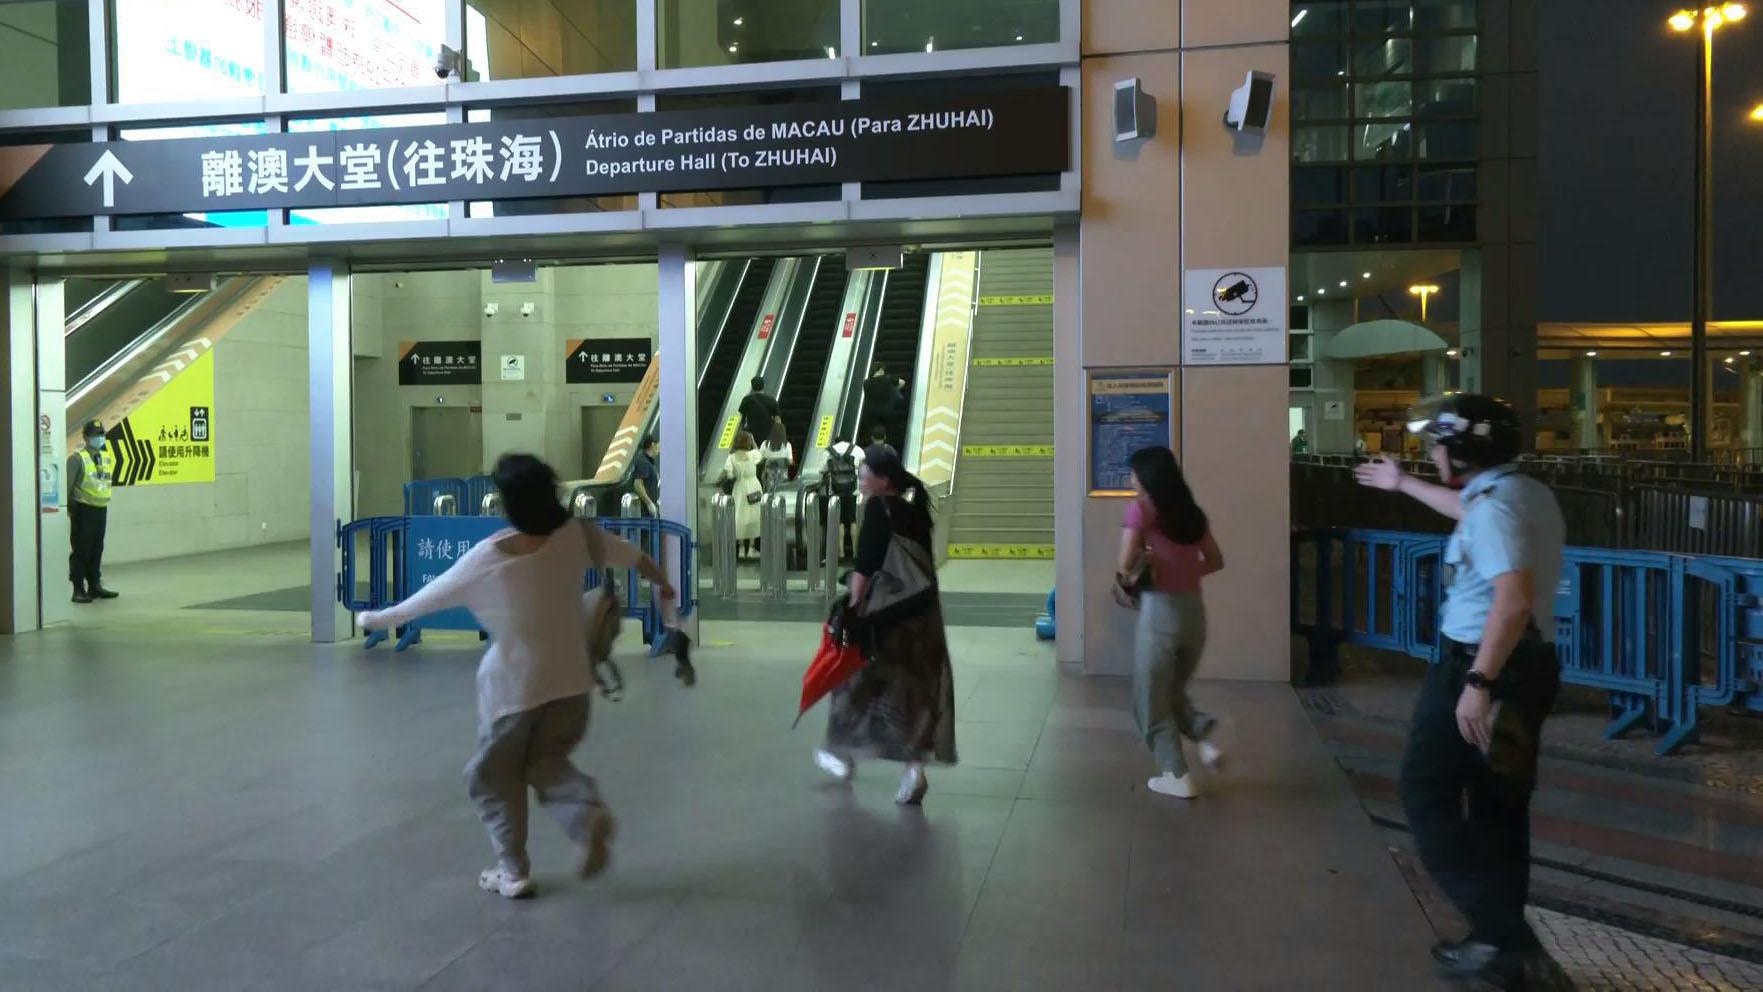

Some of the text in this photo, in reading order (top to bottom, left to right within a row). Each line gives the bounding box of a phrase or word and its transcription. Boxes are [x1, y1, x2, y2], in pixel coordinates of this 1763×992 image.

[585, 108, 994, 150] Átrio de Partidas de MACAU (Para ZHUHAI)
[201, 129, 562, 198] 離澳大堂(往珠海)
[585, 146, 837, 177] Departure Hall (To ZHUHAI)
[159, 445, 209, 458] 請使用升降機
